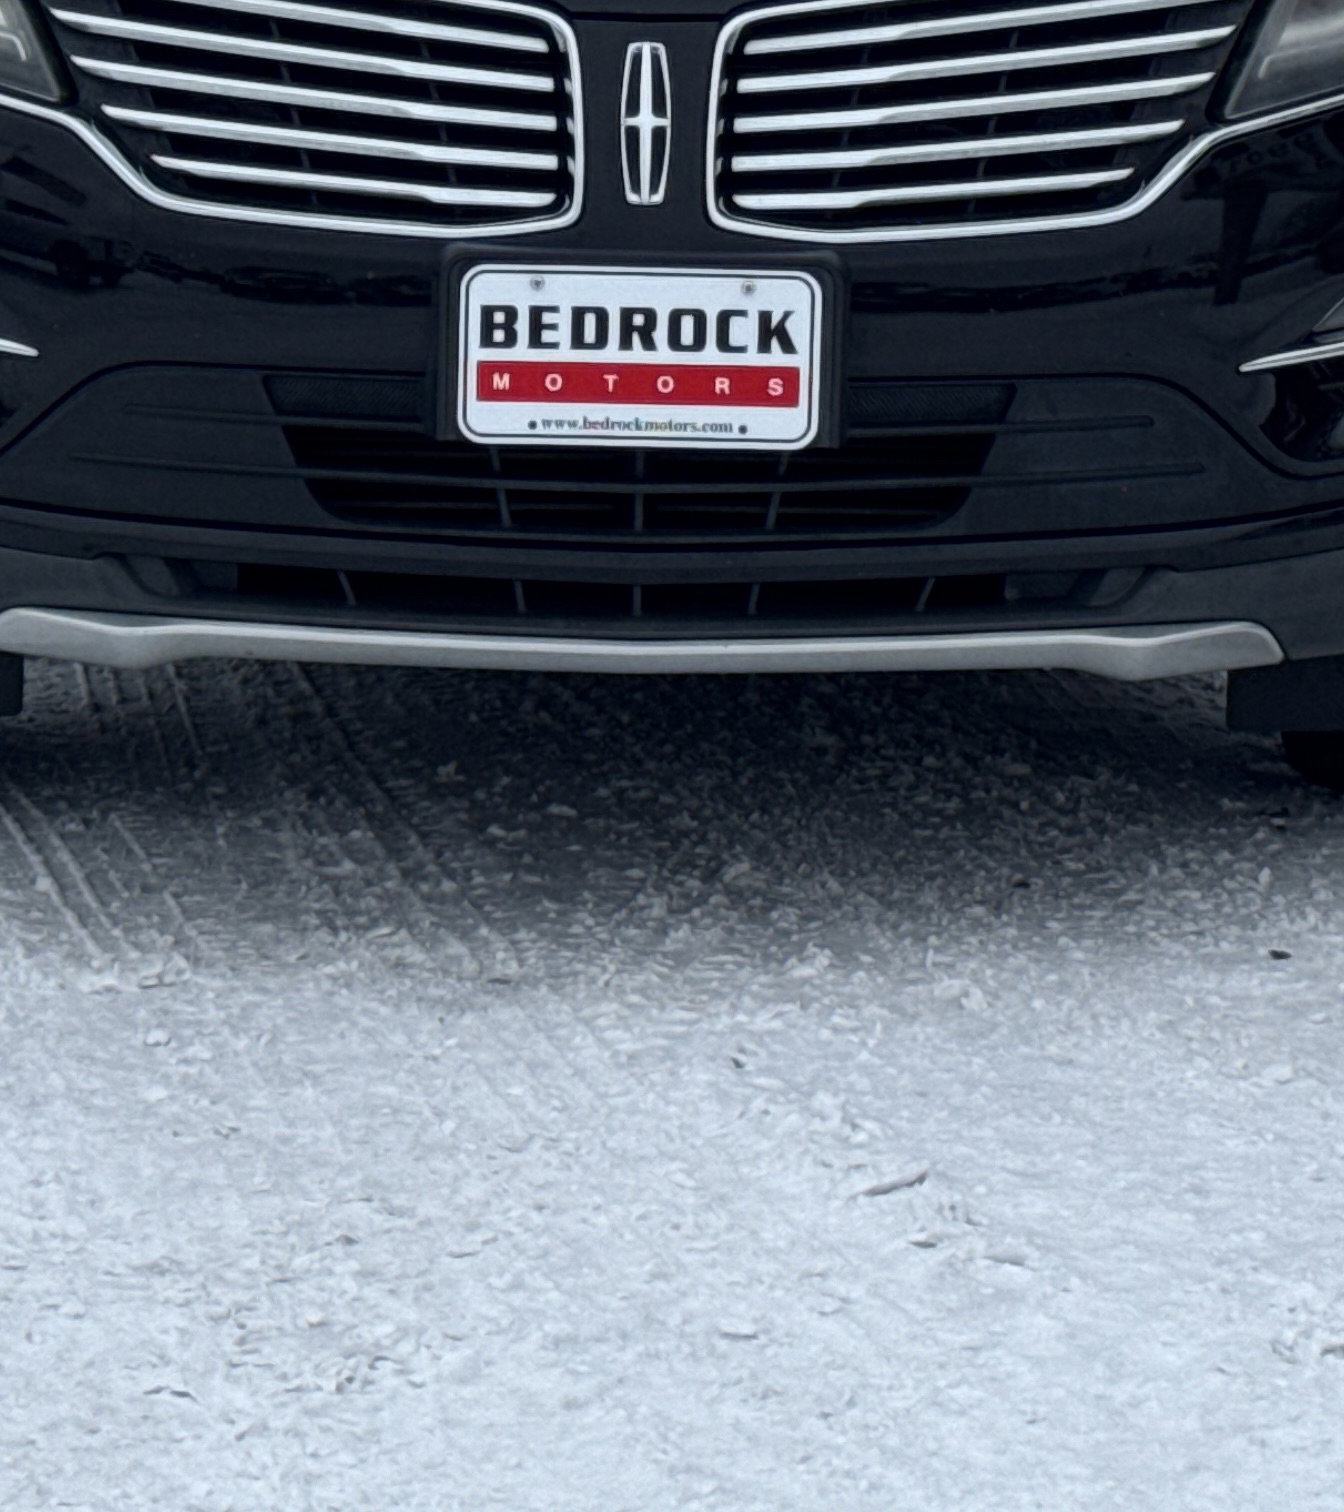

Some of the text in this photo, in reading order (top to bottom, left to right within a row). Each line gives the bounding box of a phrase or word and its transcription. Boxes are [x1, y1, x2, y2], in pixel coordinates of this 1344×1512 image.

[478, 303, 799, 355] BEDROCK
[491, 370, 785, 397] MOTORS
[540, 415, 734, 434] www.bedrockmotors.com
